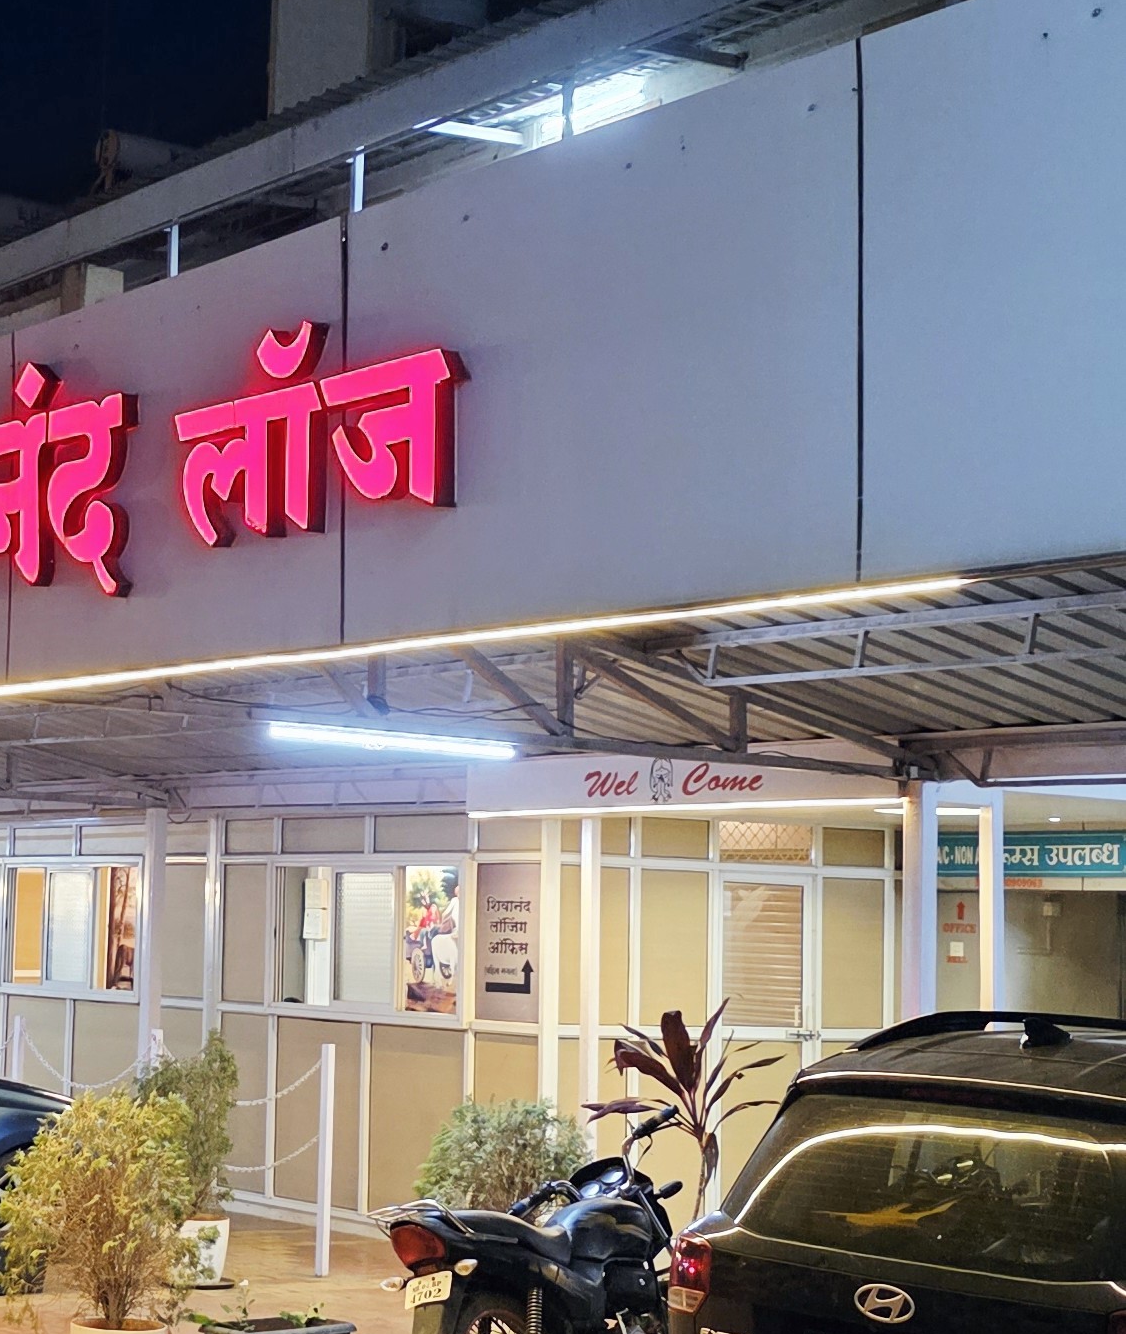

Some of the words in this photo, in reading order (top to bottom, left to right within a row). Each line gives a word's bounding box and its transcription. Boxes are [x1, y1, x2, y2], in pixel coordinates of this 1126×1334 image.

[174, 321, 462, 547] लॉज
[584, 770, 639, 798] Wel
[681, 762, 765, 796] Come
[1044, 842, 1120, 866] उपलब्ध
[486, 895, 532, 914] शिवानंद
[942, 922, 977, 934] OFFICE
[487, 937, 529, 956] ऑफिस
